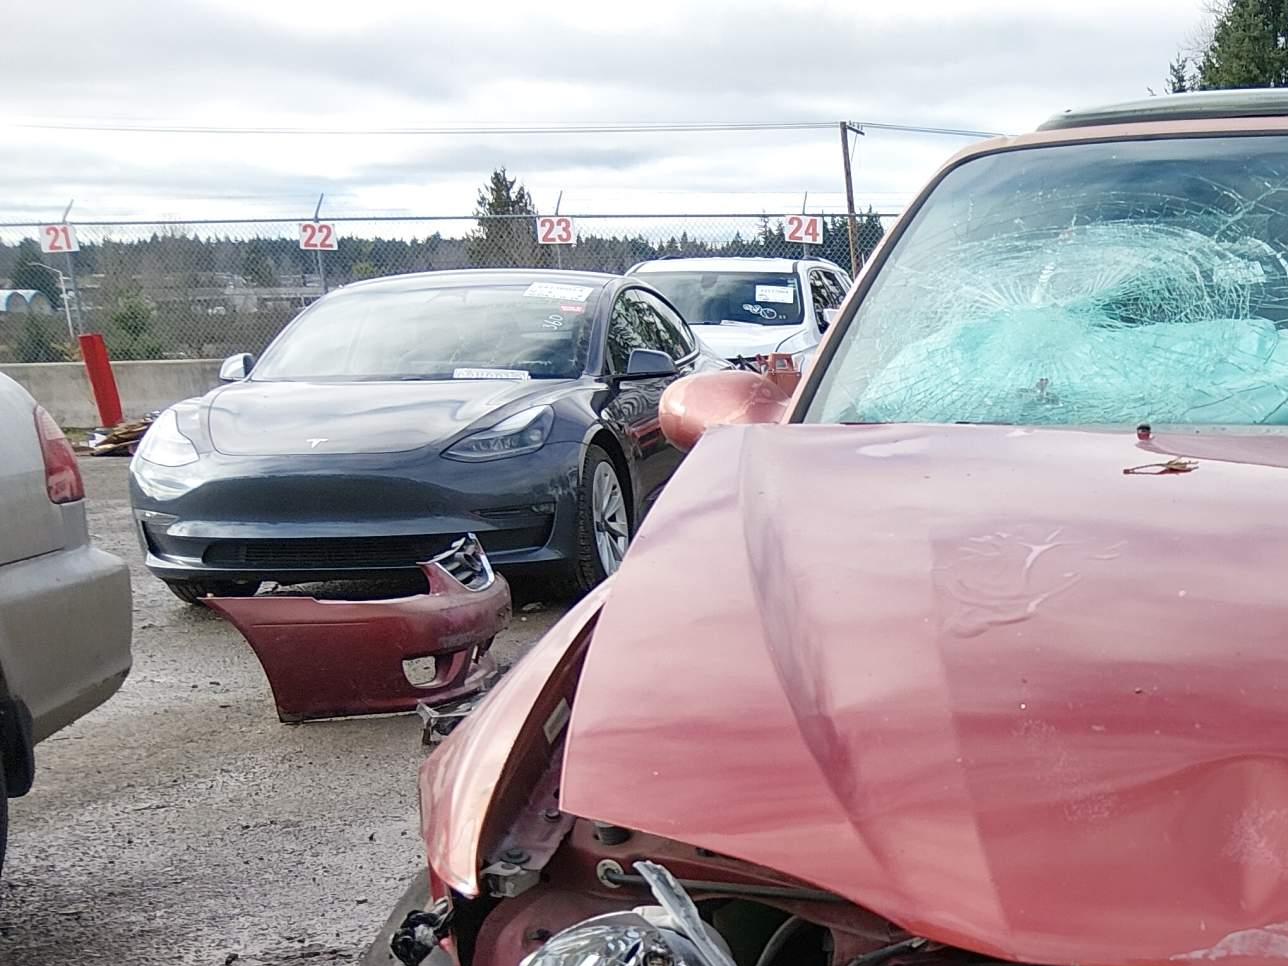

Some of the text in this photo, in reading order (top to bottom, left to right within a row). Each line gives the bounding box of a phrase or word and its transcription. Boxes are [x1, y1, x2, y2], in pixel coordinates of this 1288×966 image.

[45, 226, 73, 251] 21
[302, 223, 335, 249] 22
[540, 218, 572, 243] 23
[787, 216, 820, 242] 24
